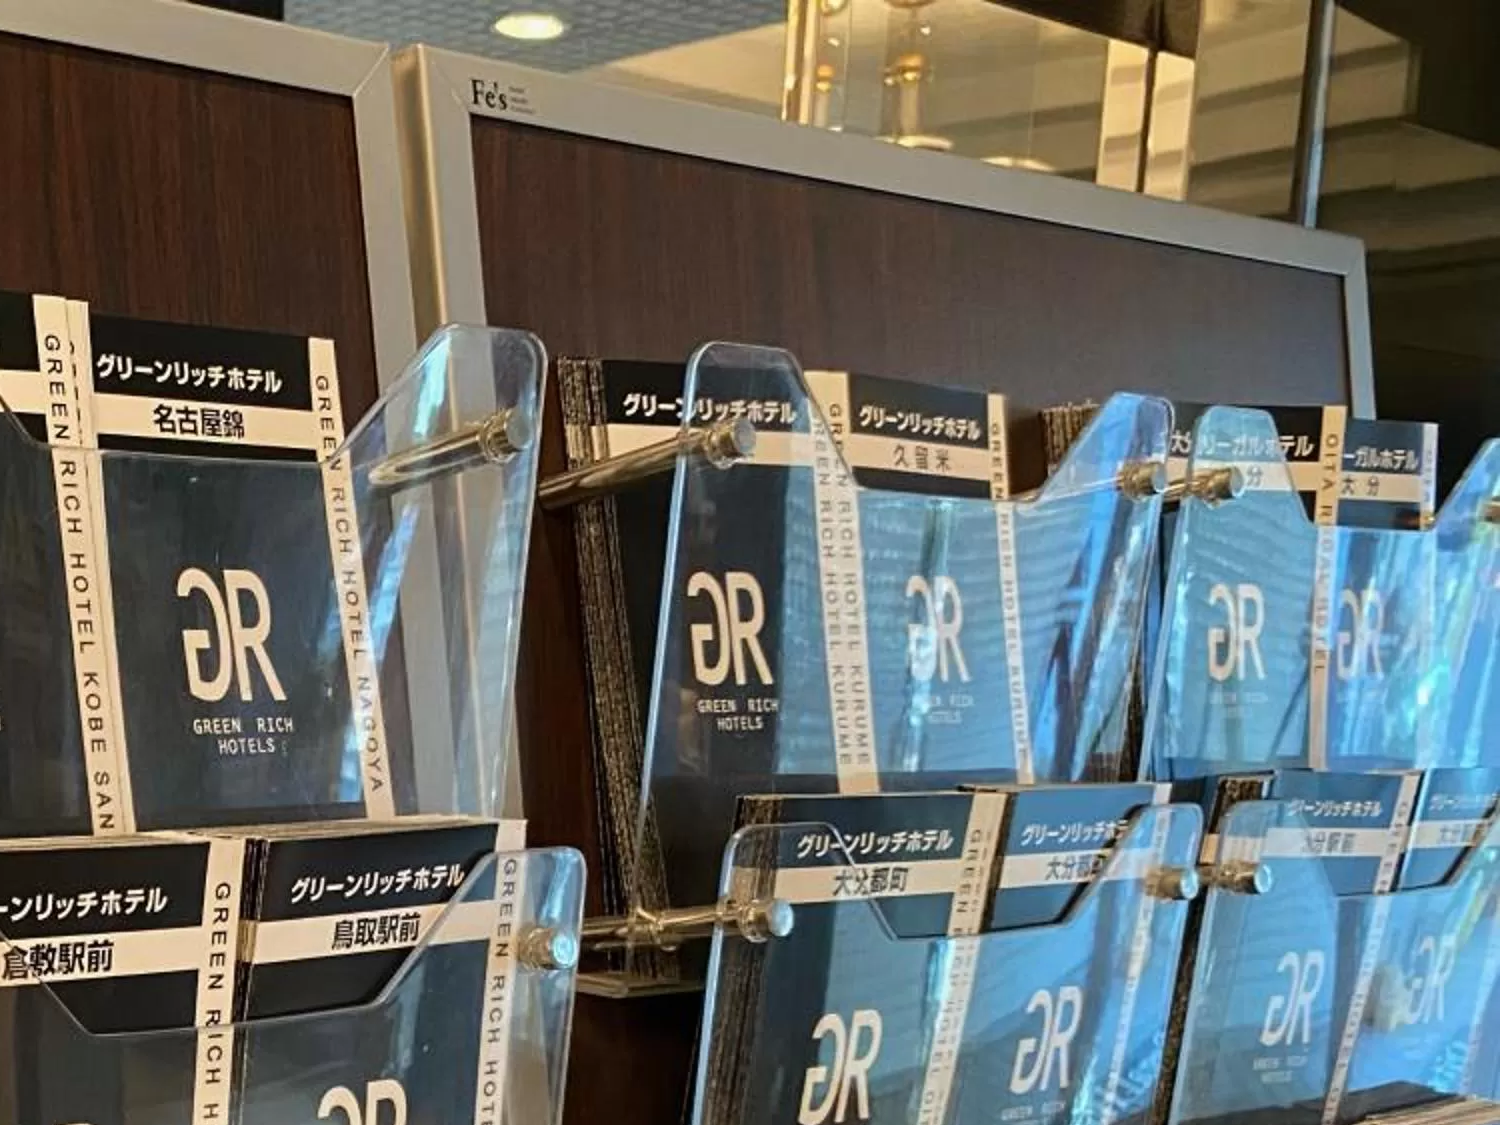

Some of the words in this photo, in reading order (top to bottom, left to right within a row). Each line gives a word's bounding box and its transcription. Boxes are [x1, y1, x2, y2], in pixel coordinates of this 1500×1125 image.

[45, 334, 71, 440] GREEN
[97, 353, 283, 395] グリーンリッチホテル
[152, 404, 245, 440] 名古屋錦
[860, 404, 981, 442] グリーンリッチホテル
[892, 445, 951, 471] 久留米
[59, 460, 83, 534] RICH
[70, 553, 96, 654] HOTEL
[315, 376, 342, 472] GREEN
[331, 487, 353, 556] RICH
[342, 569, 366, 660] HOTEL
[357, 677, 385, 792] NAGOYA
[83, 671, 107, 753] KOBE
[192, 718, 242, 735] GREEN
[257, 717, 294, 734] RICH
[697, 700, 736, 714] GREEN
[747, 698, 780, 713] RICH
[716, 716, 764, 731] HOTELS
[218, 737, 276, 755] HOTELS
[797, 830, 954, 858] グリーンリッチホテル
[291, 862, 464, 903] グリーンリッチホテル
[496, 858, 517, 959] GREEN
[208, 882, 231, 991] GREEN
[332, 913, 421, 951] 鳥取駅前
[2, 940, 115, 981] 倉敷駅前
[488, 975, 507, 1045] RICH
[204, 1008, 223, 1085] RICH
